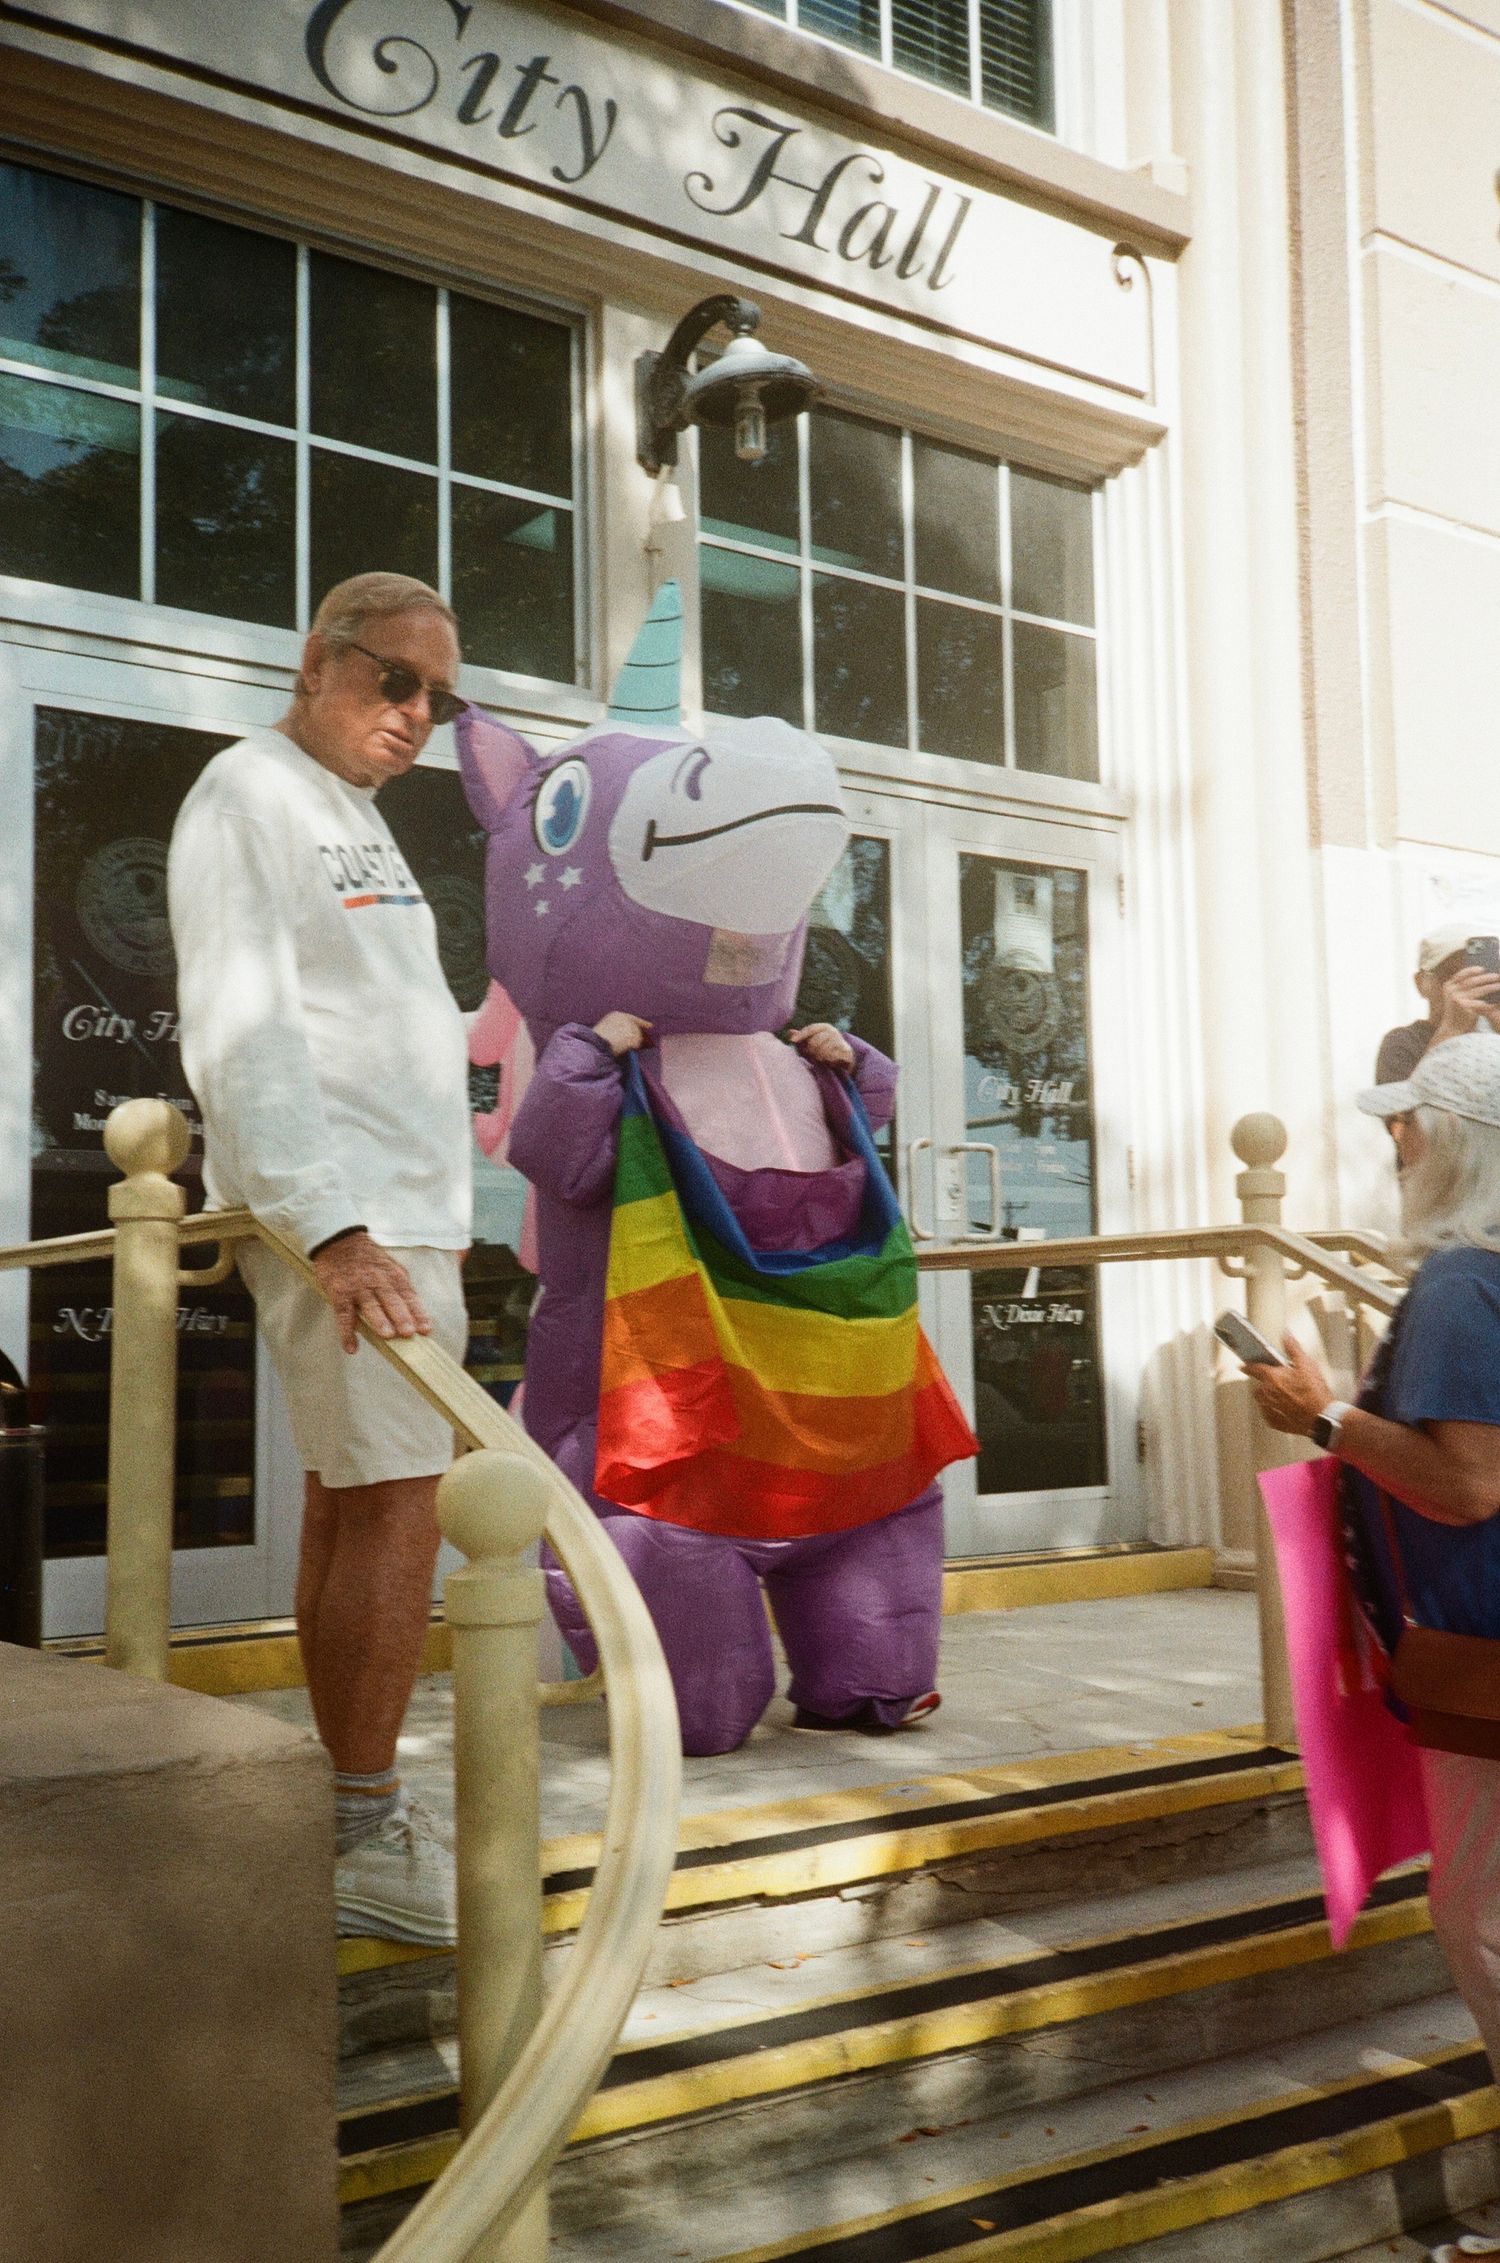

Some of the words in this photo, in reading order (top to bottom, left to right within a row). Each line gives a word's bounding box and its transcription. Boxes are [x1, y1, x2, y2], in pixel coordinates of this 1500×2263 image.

[305, 0, 618, 184] City
[683, 106, 974, 291] Hall
[62, 1004, 136, 1044] City
[1024, 1078, 1074, 1103] Hall
